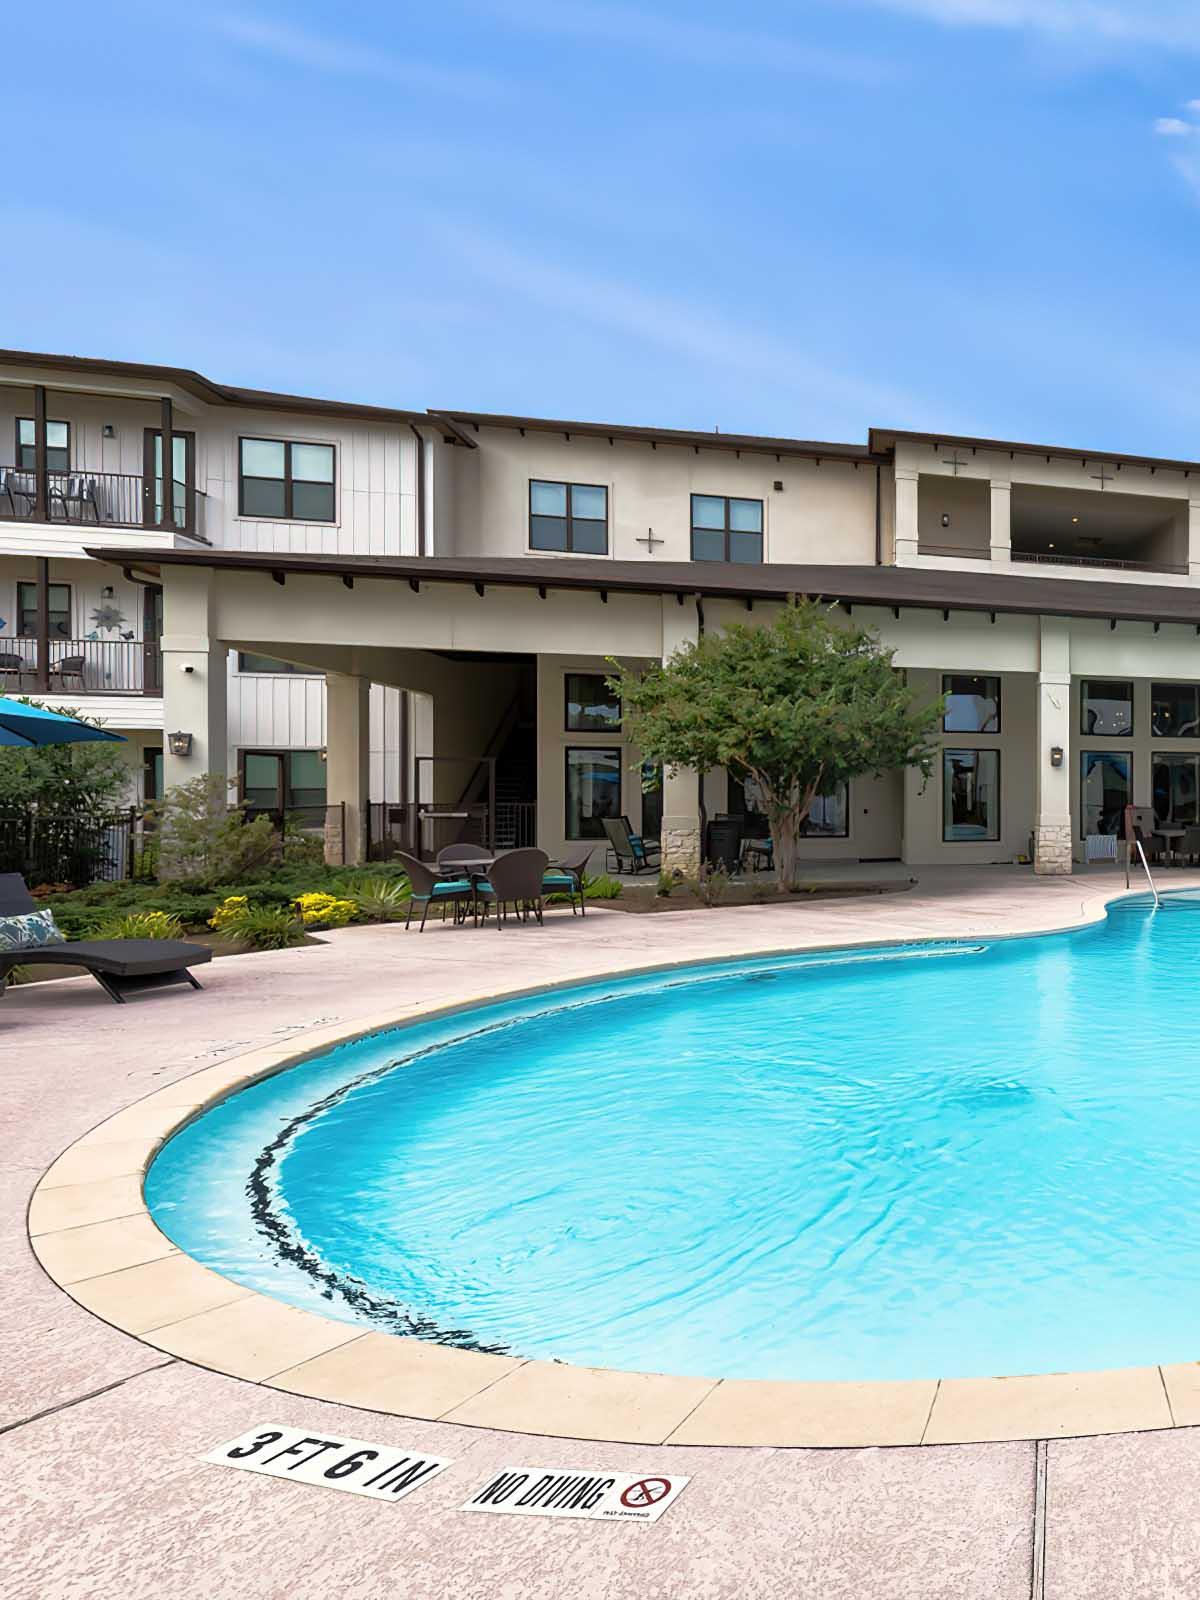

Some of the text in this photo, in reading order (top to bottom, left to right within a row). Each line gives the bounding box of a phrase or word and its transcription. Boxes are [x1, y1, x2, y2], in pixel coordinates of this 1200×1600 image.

[226, 1431, 440, 1494] 3 FT 6 IN
[471, 1472, 617, 1510] NO DIVING
